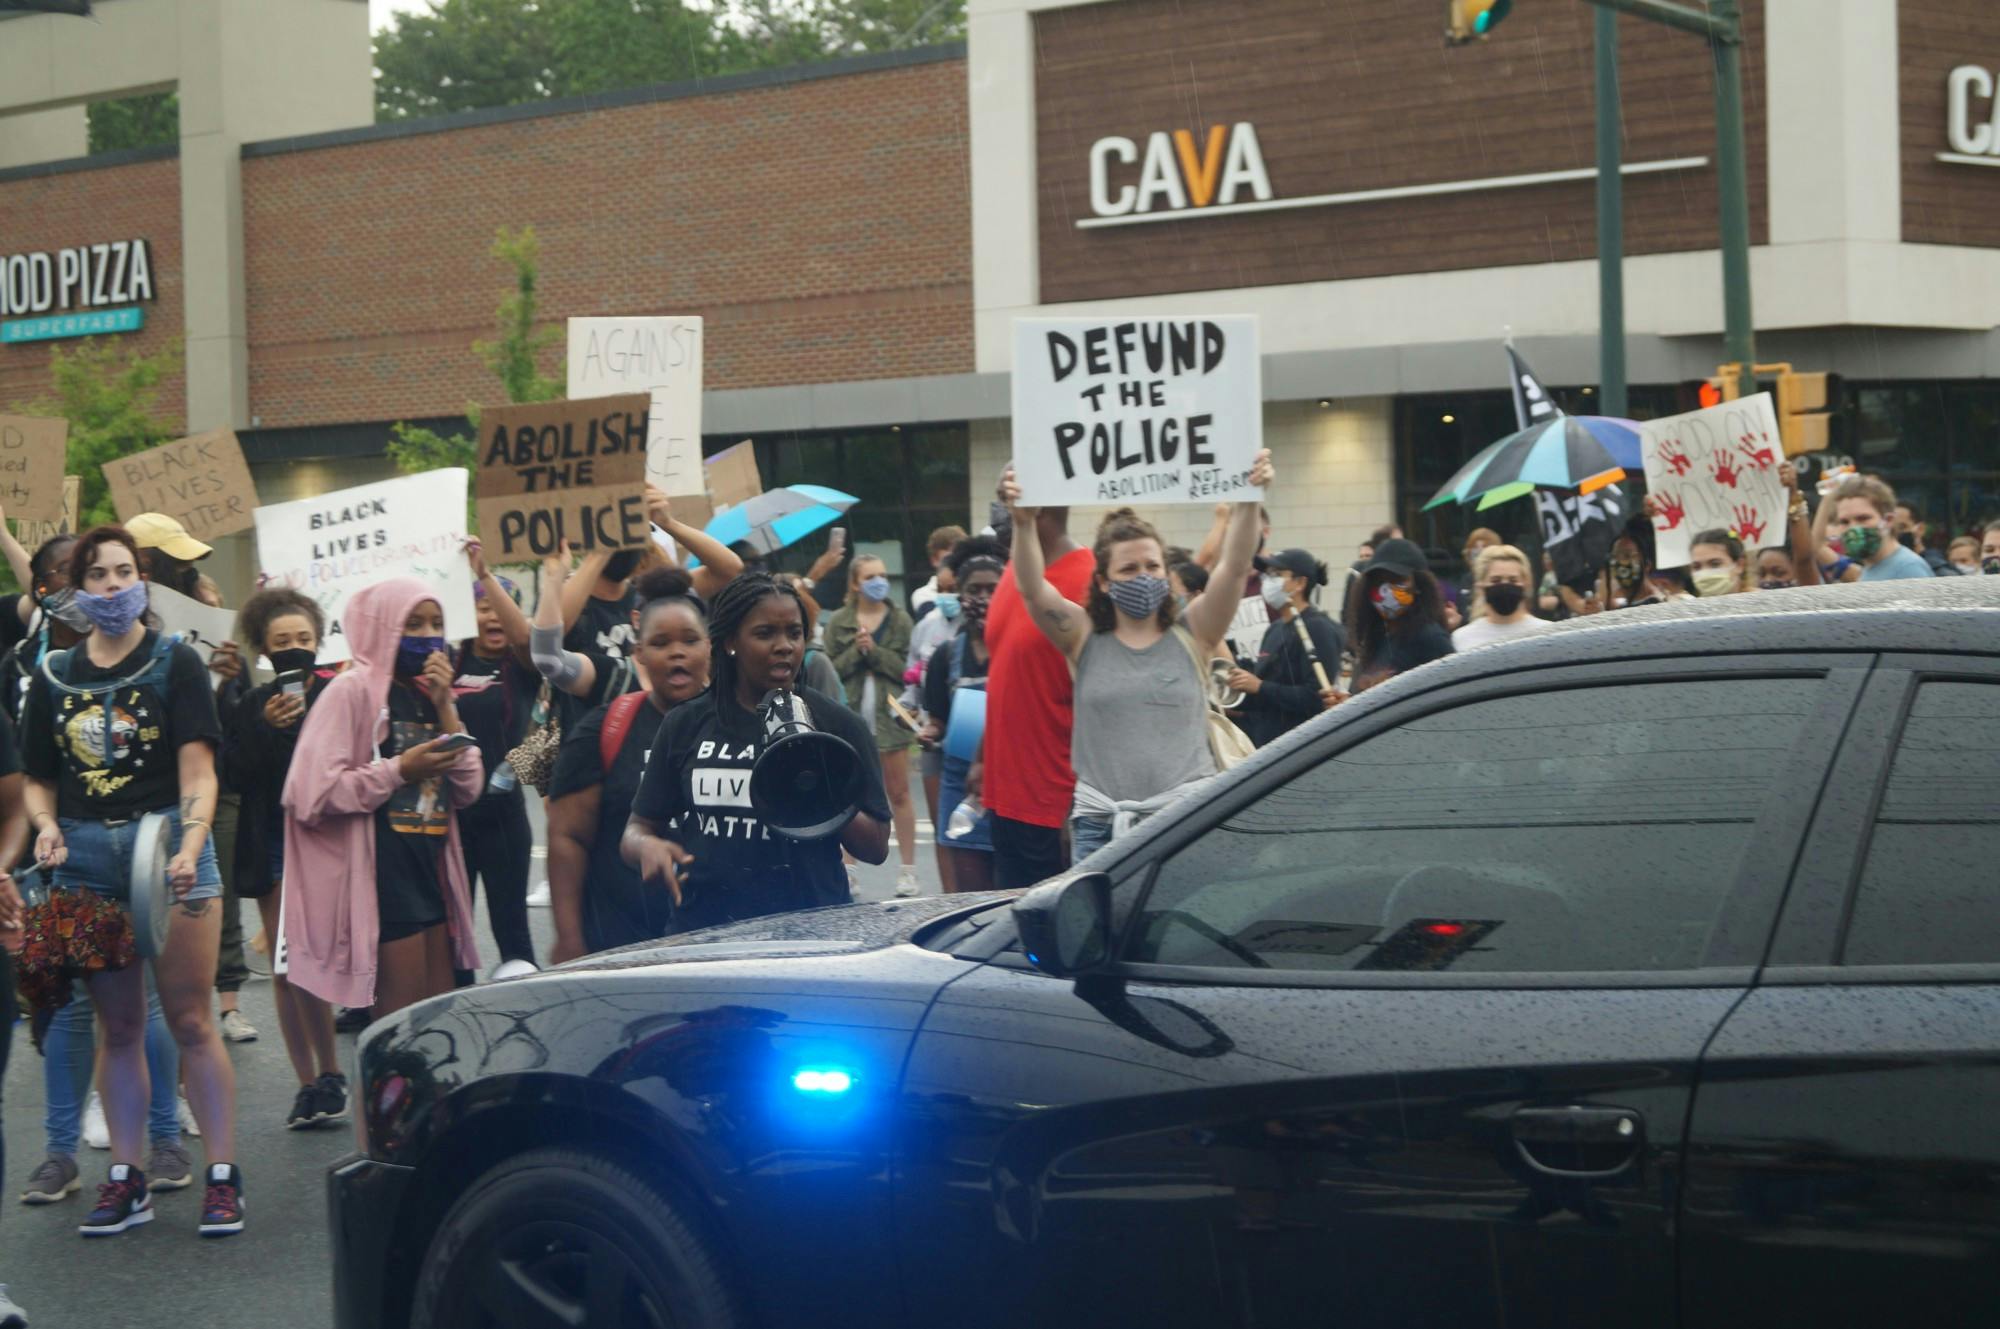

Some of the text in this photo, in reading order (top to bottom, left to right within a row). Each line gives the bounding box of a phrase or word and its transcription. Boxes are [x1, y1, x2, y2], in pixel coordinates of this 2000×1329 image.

[1090, 121, 1272, 217] CAVA
[59, 239, 152, 309] PIZZA
[10, 313, 130, 338] SUPERFAST
[1046, 321, 1225, 383] DEFUND
[1080, 380, 1166, 412] THE
[484, 411, 650, 466] ABOLISH
[1053, 413, 1215, 480] POLICE
[122, 441, 217, 486] BLACK
[517, 460, 594, 493] THE
[136, 469, 225, 513] LIVES
[1097, 468, 1222, 500] ABOLITION NOT
[178, 496, 243, 532] TTER
[309, 498, 388, 531] BLACK
[500, 495, 645, 555] POLICE
[312, 529, 388, 560] LIVES
[697, 741, 755, 760] BLA
[699, 778, 744, 797] LIV
